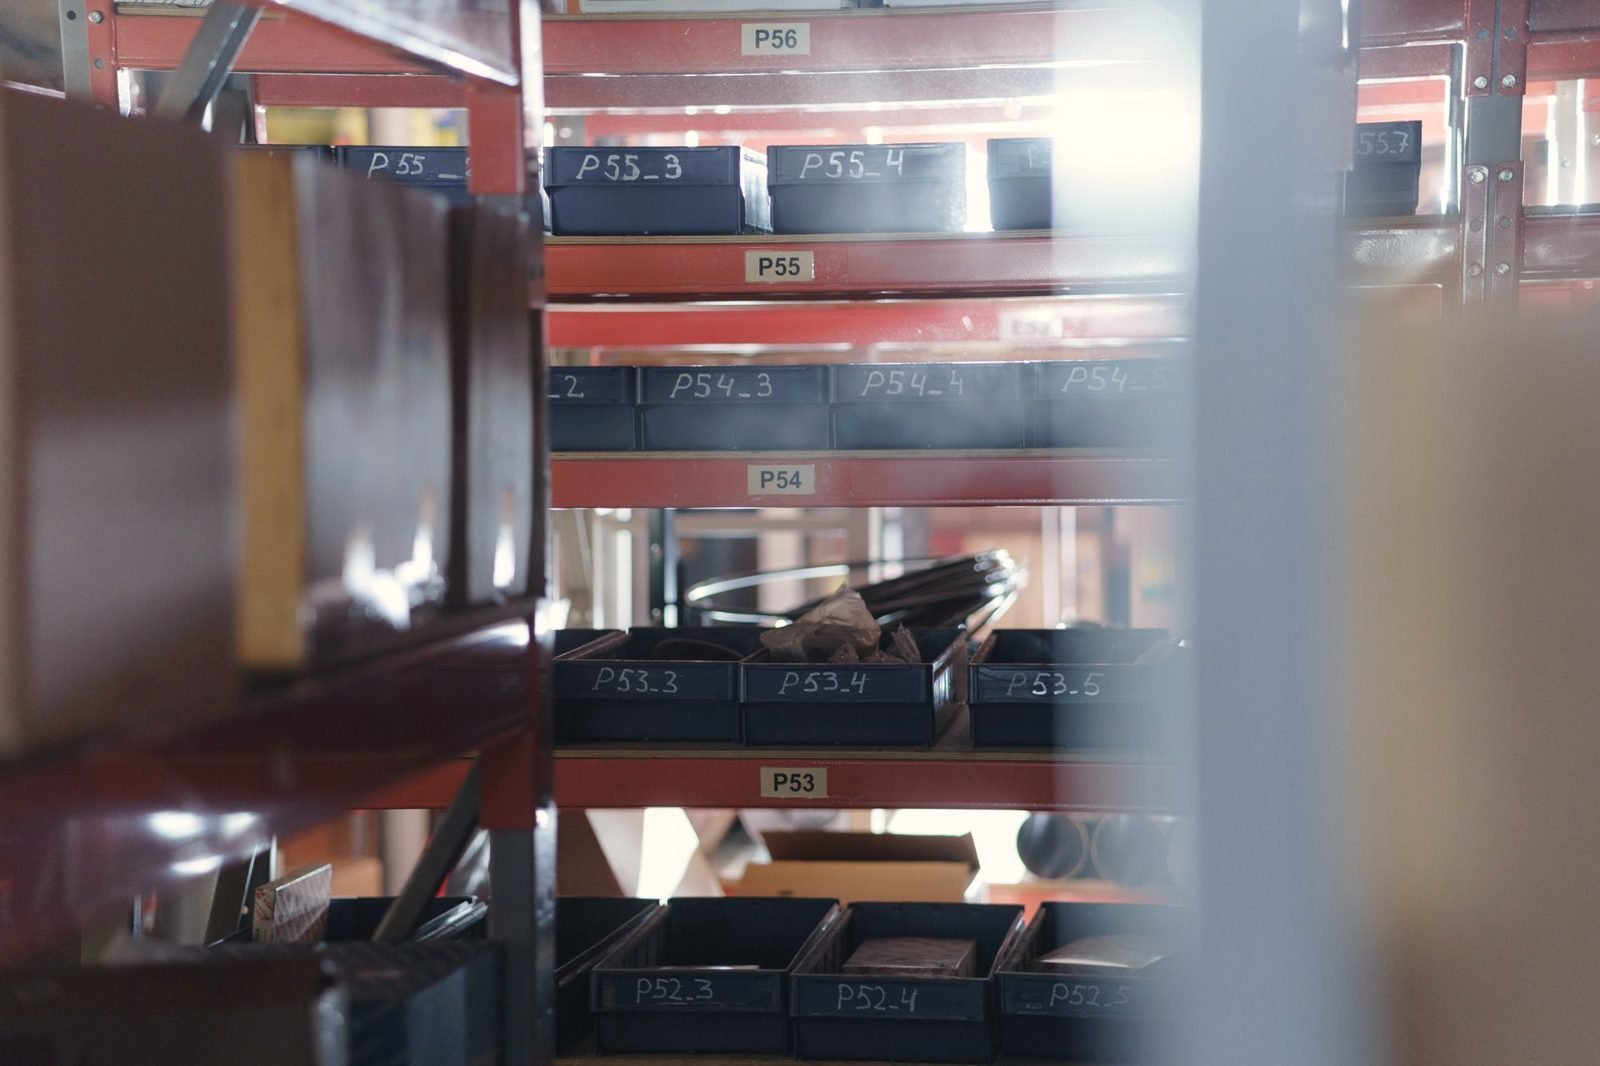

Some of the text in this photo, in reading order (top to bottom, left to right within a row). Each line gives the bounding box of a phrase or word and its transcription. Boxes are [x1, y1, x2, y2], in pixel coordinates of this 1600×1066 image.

[755, 29, 797, 49] P56
[1356, 130, 1409, 155] 55_7
[576, 154, 683, 181] P55_3
[799, 149, 905, 179] P55_4
[759, 257, 800, 276] P55
[669, 373, 773, 399] P54_3
[861, 370, 964, 397] P54_4
[760, 470, 802, 489] P54
[774, 773, 815, 793] P53
[636, 978, 714, 1004] P52_3
[837, 984, 919, 1012] P52_4
